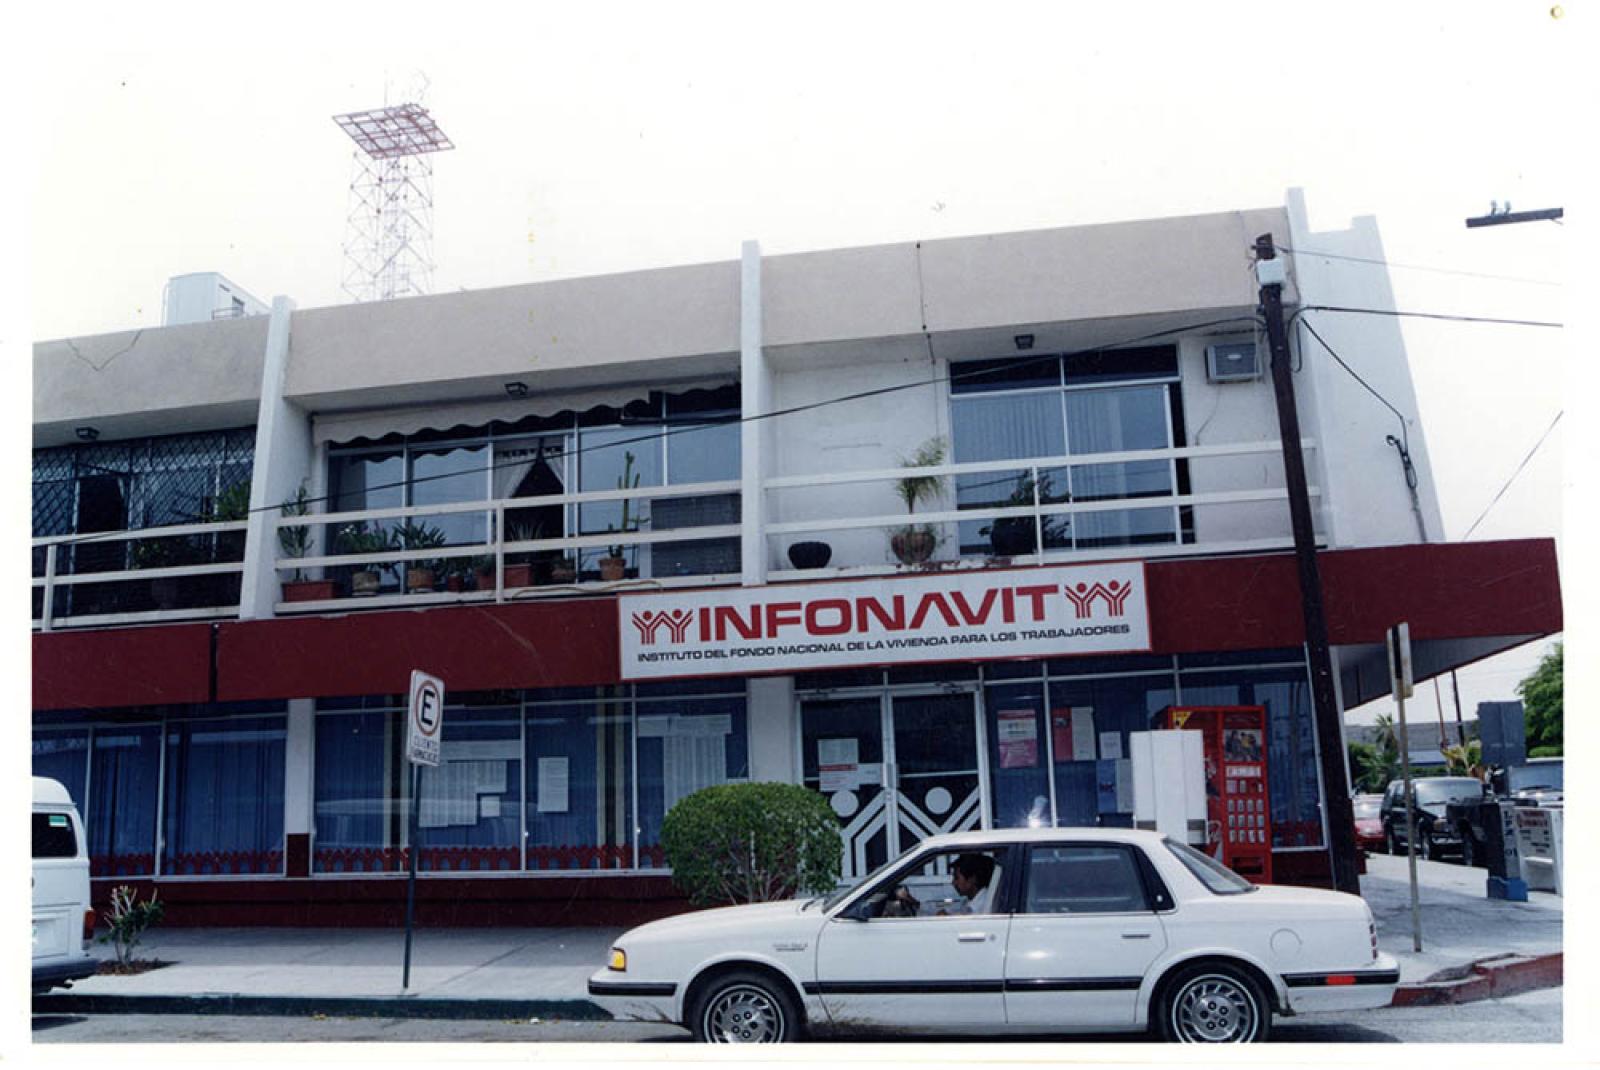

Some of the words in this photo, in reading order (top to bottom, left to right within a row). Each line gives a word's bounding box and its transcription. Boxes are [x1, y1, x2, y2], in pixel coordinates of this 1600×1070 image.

[699, 585, 1059, 641] INFONAVIT
[638, 650, 702, 662] INSTITUTO
[704, 649, 729, 660] DEL
[730, 646, 775, 658] FONDO
[777, 642, 843, 656] NACIONAL
[847, 640, 865, 652] DE
[867, 639, 884, 650] LA
[886, 636, 948, 649] VIVIENDA
[951, 634, 988, 644] PARA
[991, 631, 1017, 642] LOS
[1020, 624, 1130, 639] TRABAJADORES
[421, 689, 436, 726] E
